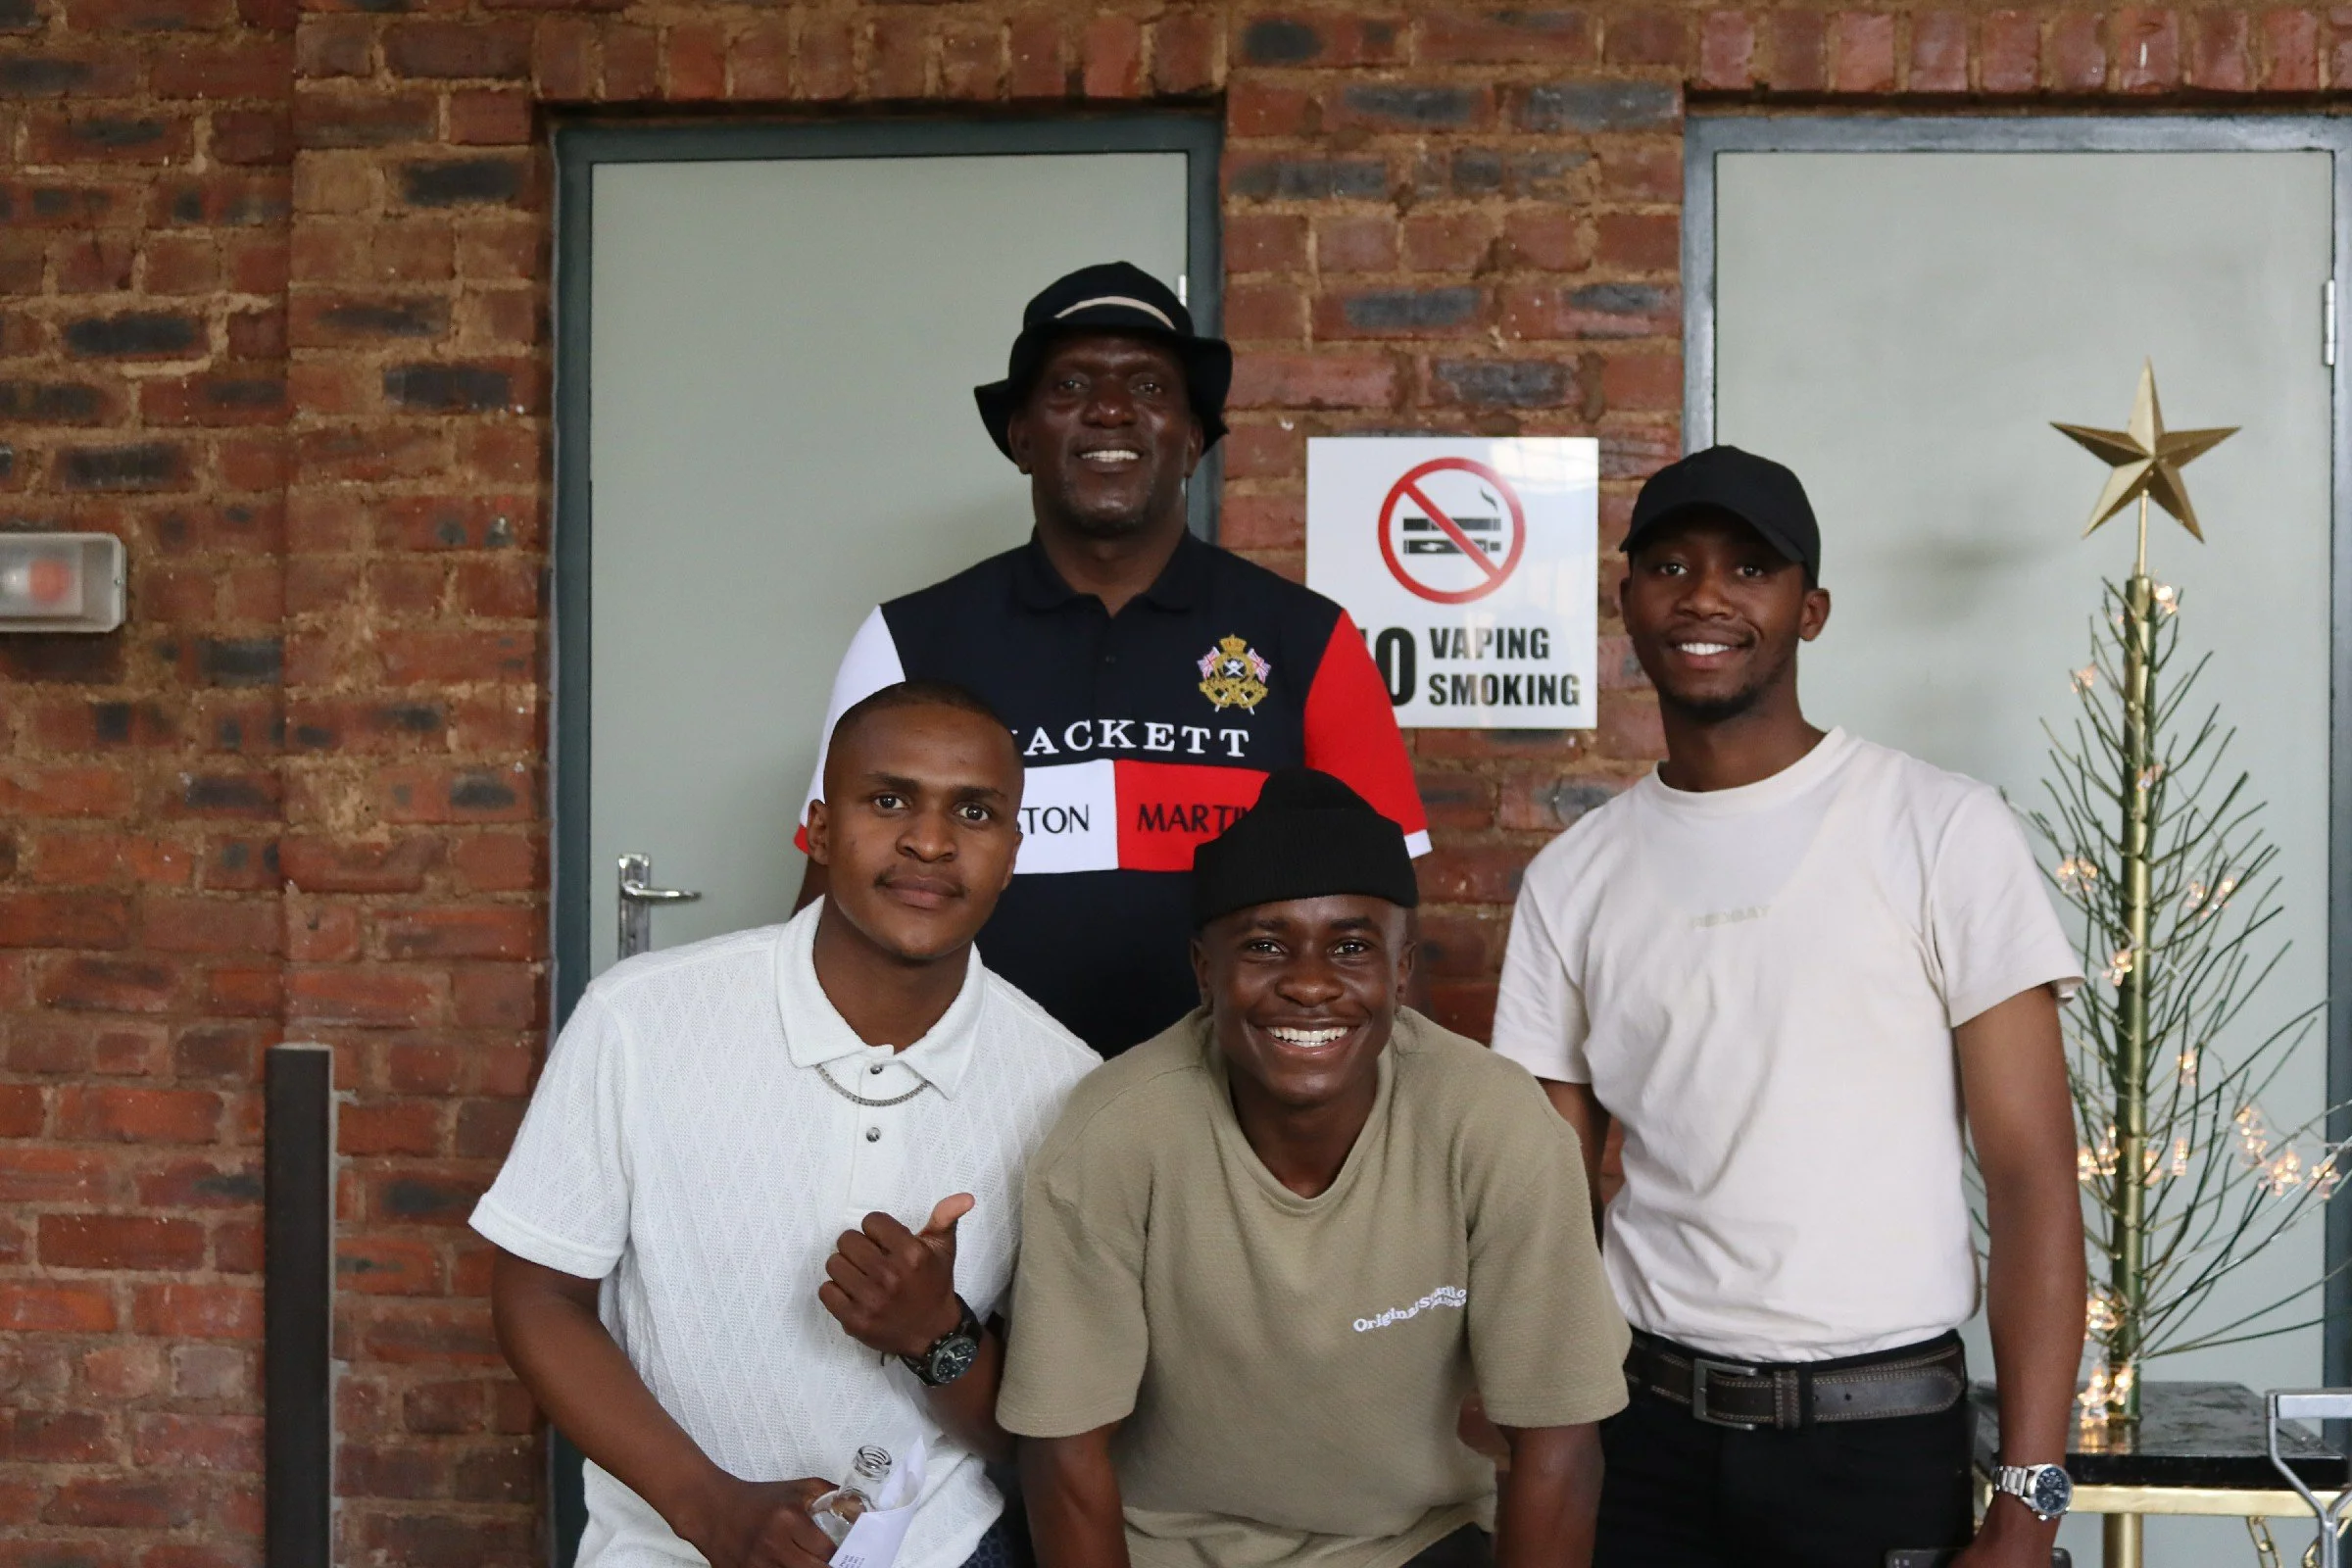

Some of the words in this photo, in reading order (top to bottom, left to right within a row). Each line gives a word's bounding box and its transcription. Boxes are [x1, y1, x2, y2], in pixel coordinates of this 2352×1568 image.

[1429, 628, 1549, 660] VAPING
[1356, 626, 1416, 707] O
[1429, 673, 1580, 706] SMOKING
[1011, 718, 1250, 758] ACKETT
[1016, 804, 1090, 834] TON
[1137, 804, 1252, 833] MARTI
